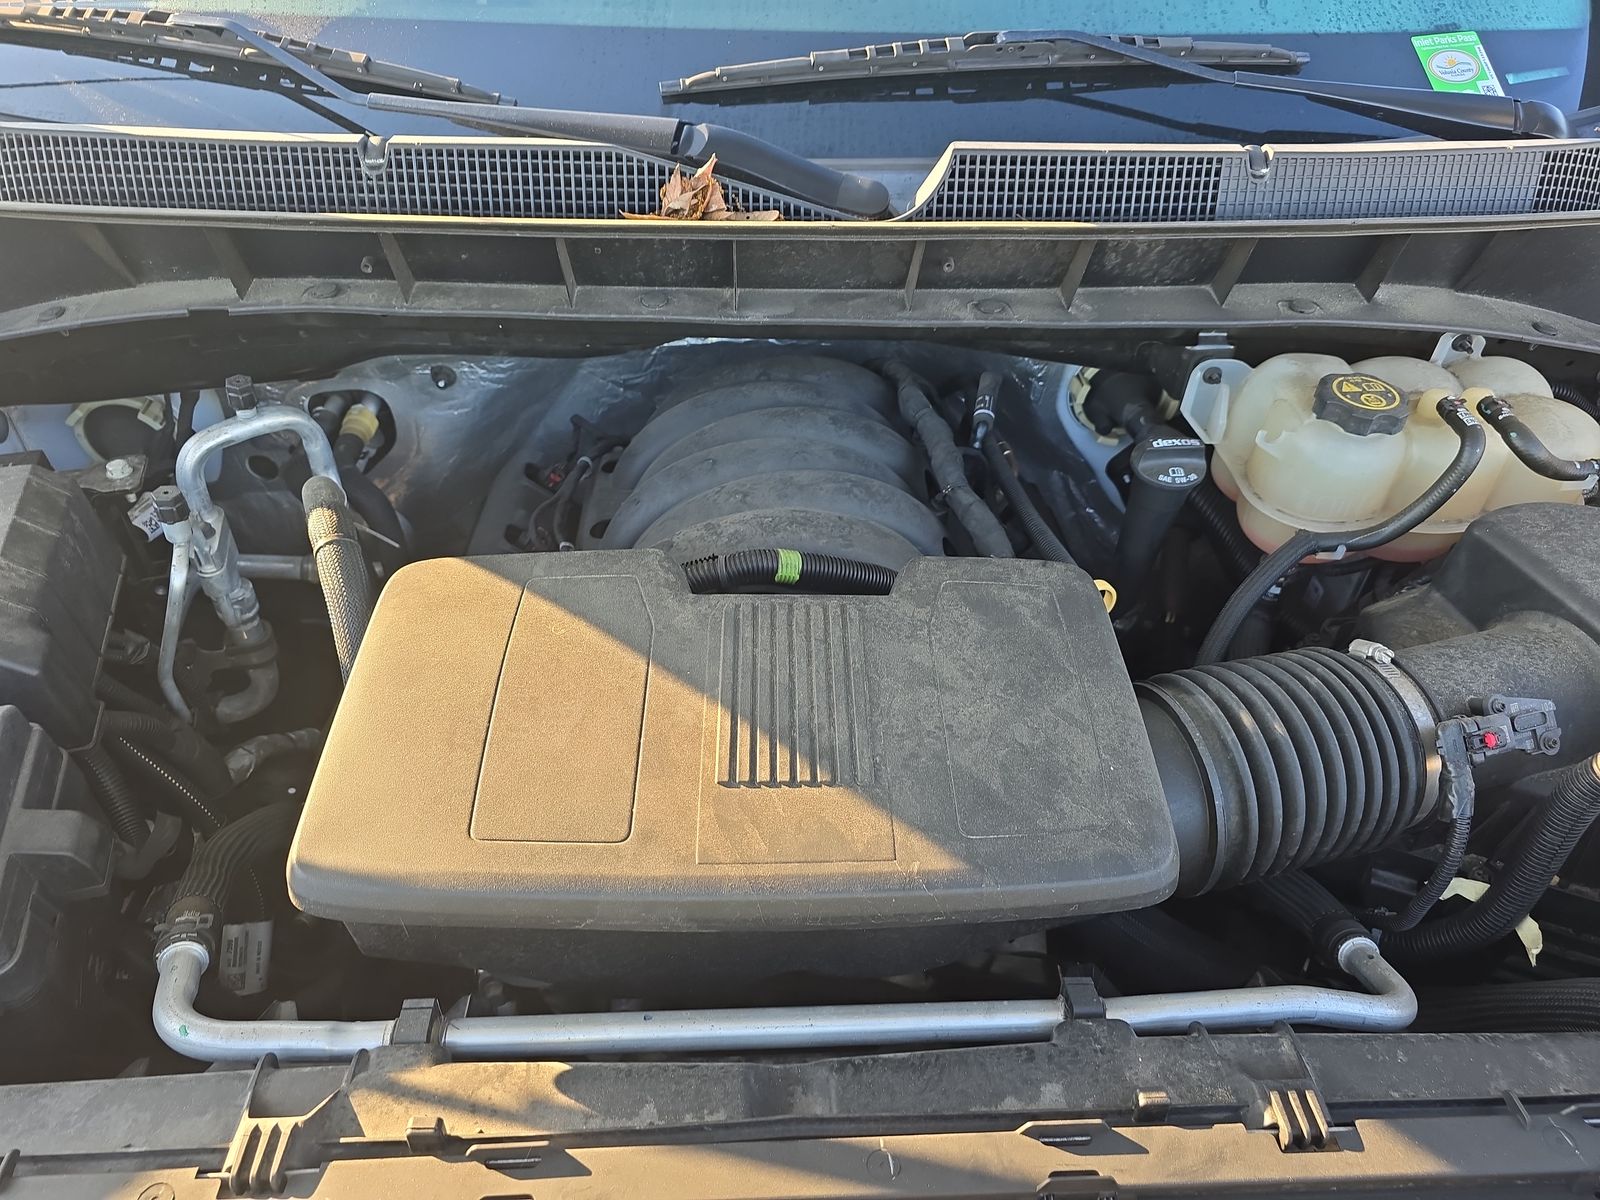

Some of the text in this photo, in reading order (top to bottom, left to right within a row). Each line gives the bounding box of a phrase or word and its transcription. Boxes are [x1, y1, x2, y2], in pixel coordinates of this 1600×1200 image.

[1413, 38, 1434, 48] Inlet
[1434, 36, 1457, 46] Parks
[1457, 34, 1477, 44] Pass
[1152, 438, 1201, 448] dexos
[1158, 474, 1173, 483] SAE
